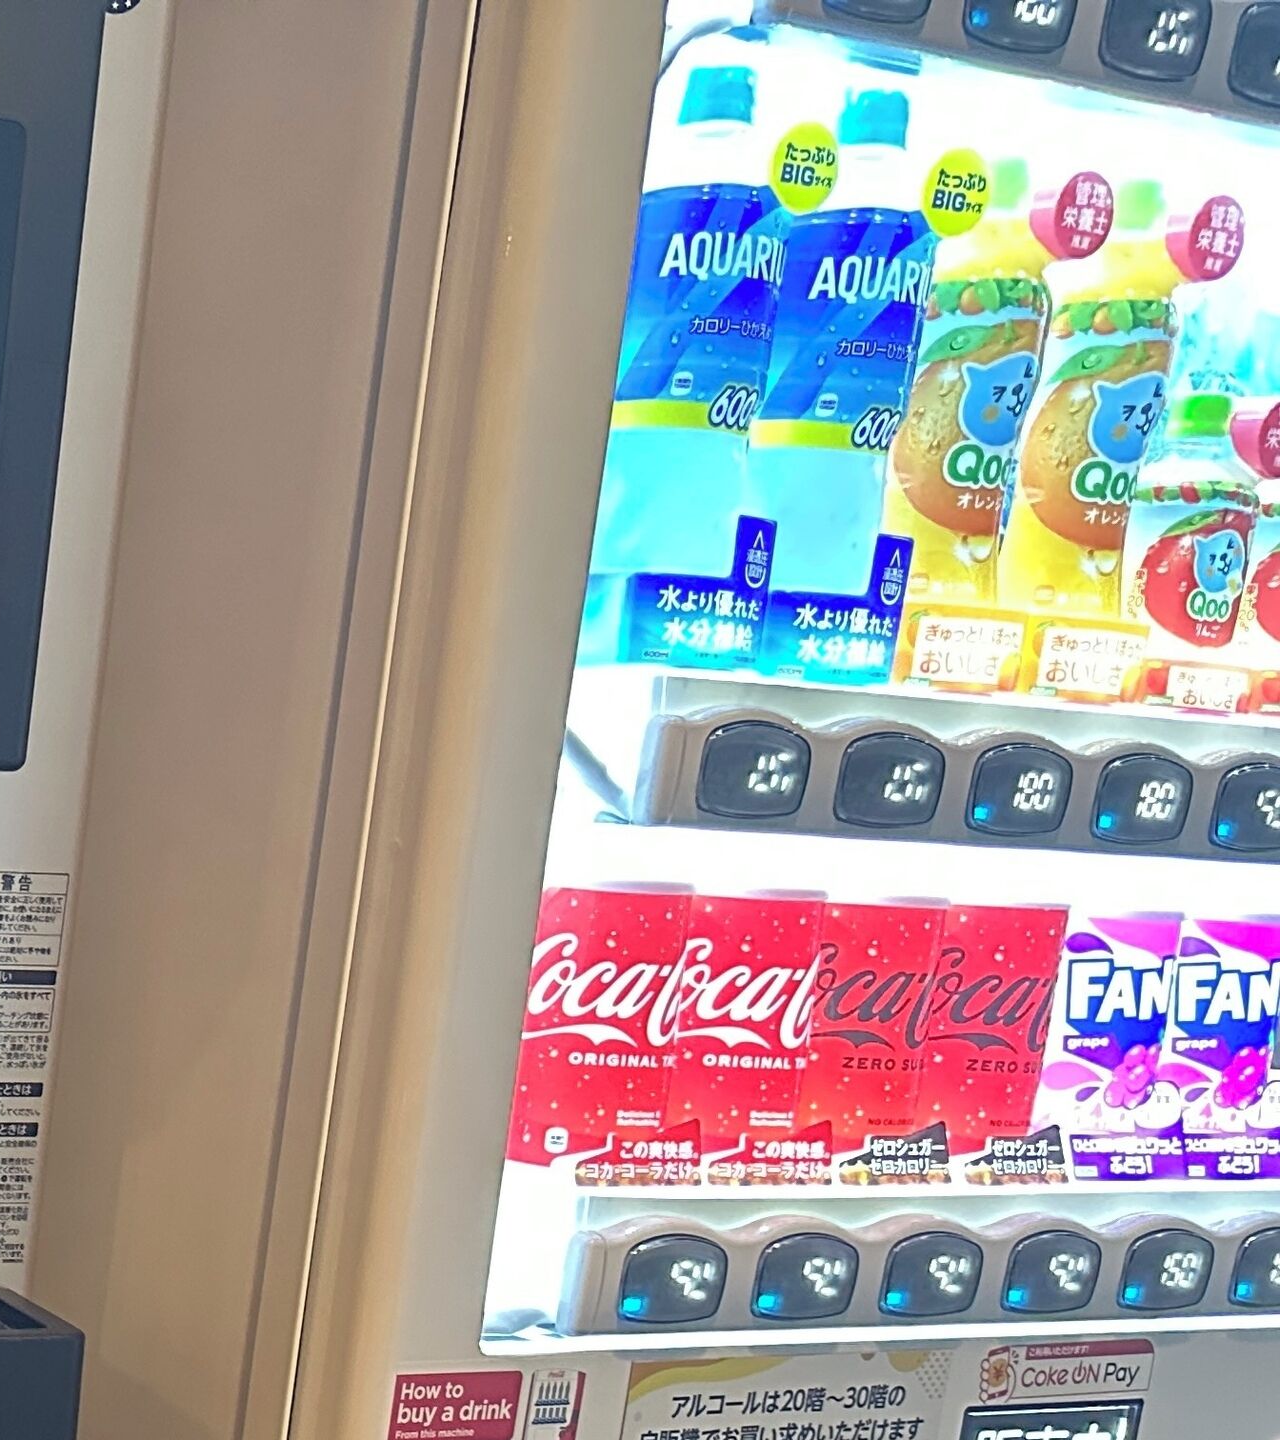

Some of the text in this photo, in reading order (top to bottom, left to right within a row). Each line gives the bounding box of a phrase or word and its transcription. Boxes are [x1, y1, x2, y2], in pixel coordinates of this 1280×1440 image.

[785, 143, 835, 166] たっぷり
[937, 169, 986, 192] たっぷり
[659, 232, 788, 285] AQUARIU
[808, 255, 934, 307] AQUARIU
[657, 584, 760, 621] 水より優れた
[1189, 591, 1228, 619] Qoo
[794, 604, 893, 637] 水より優れた
[1, 874, 32, 891] 警告
[1069, 961, 1173, 1021] FAN
[1178, 962, 1280, 1023] FAN
[1067, 1036, 1109, 1050] grape
[1176, 1038, 1217, 1051] grape
[569, 1052, 658, 1069] ORIGINAL
[702, 1054, 791, 1069] ORIGINAL
[842, 1057, 896, 1071] ZERO
[966, 1059, 1018, 1074] ZERO
[1021, 1367, 1068, 1388] Coke
[1103, 1362, 1140, 1388] Pay
[400, 1381, 464, 1400] How to
[397, 1400, 512, 1426] buy a drink
[395, 1427, 474, 1440] From this machine
